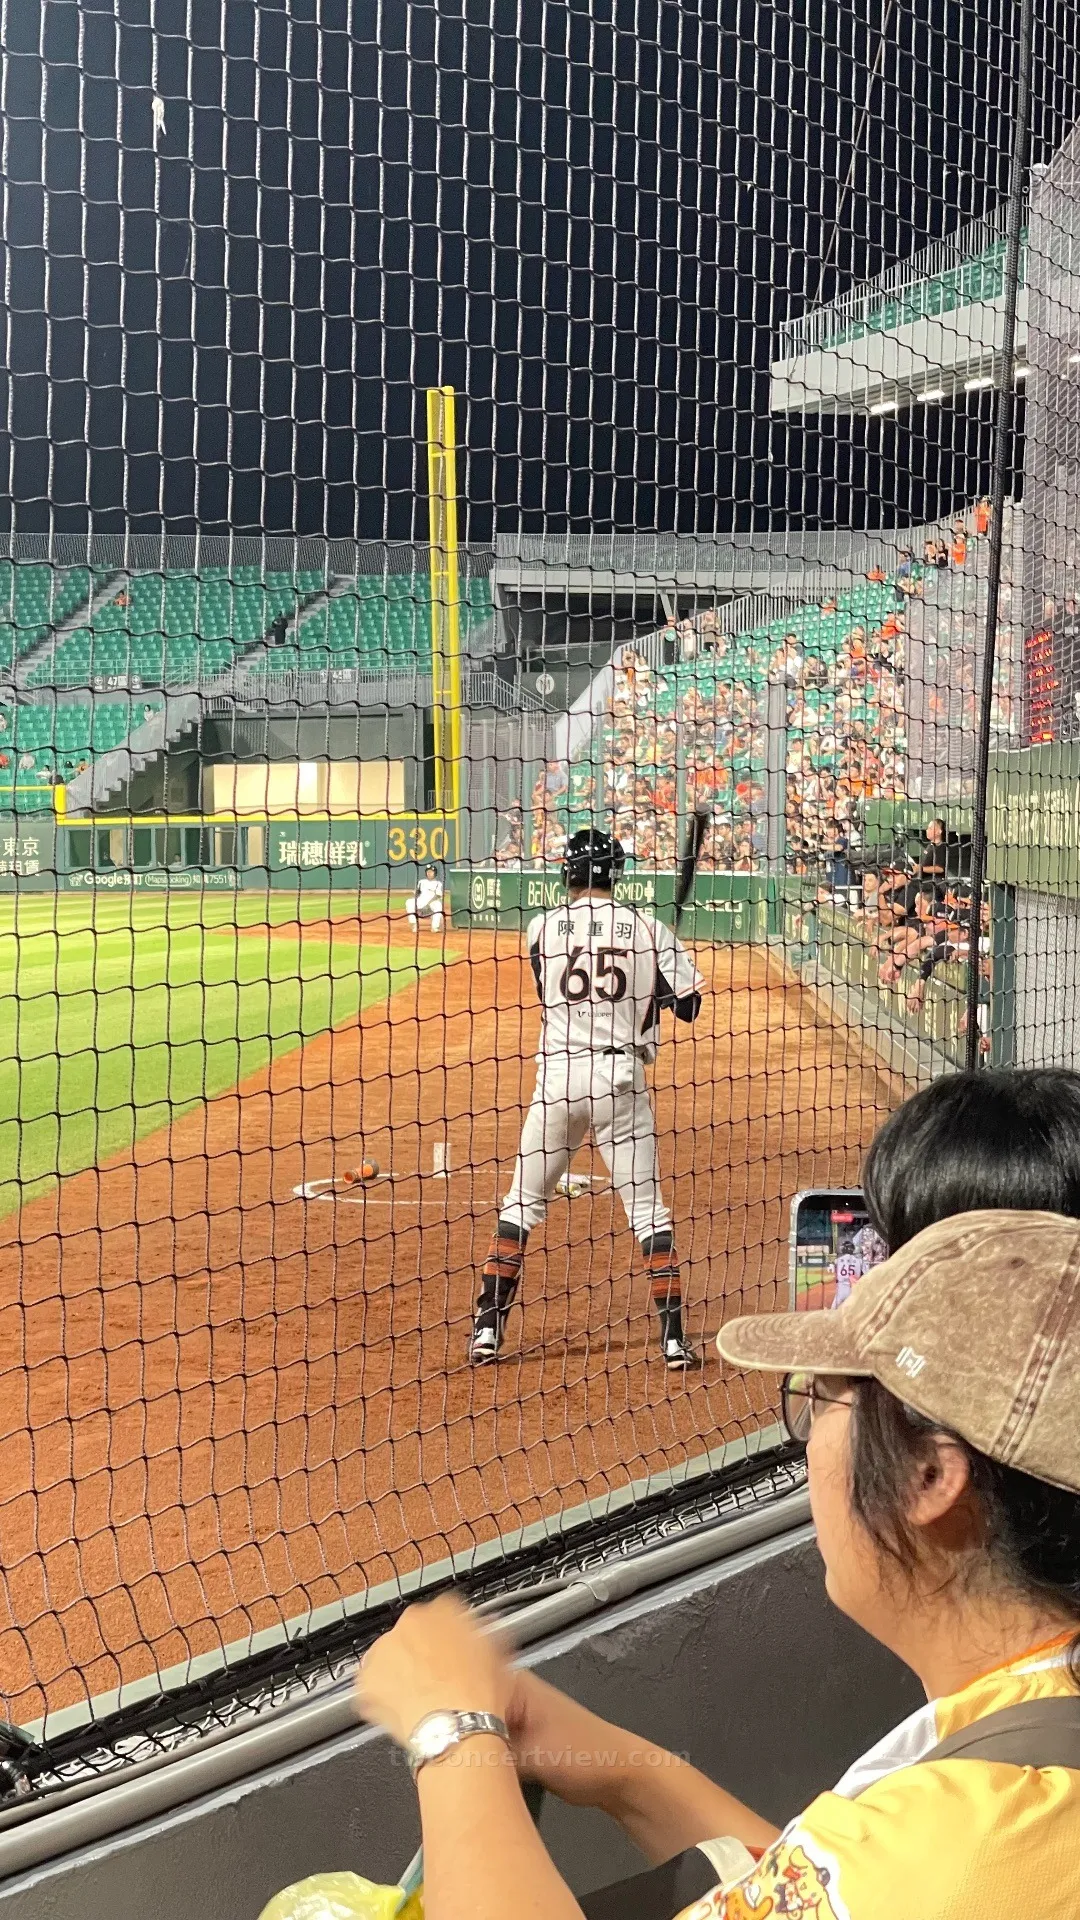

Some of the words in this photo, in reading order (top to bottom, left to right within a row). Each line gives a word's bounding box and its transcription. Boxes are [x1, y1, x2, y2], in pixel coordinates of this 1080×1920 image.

[2, 836, 40, 857] 東京
[278, 840, 367, 866] 瑞穗鮮乳
[389, 827, 449, 861] 330
[527, 880, 560, 907] BEING
[557, 919, 633, 940] 陳重羽
[559, 945, 628, 1002] 65
[840, 1265, 855, 1277] 65
